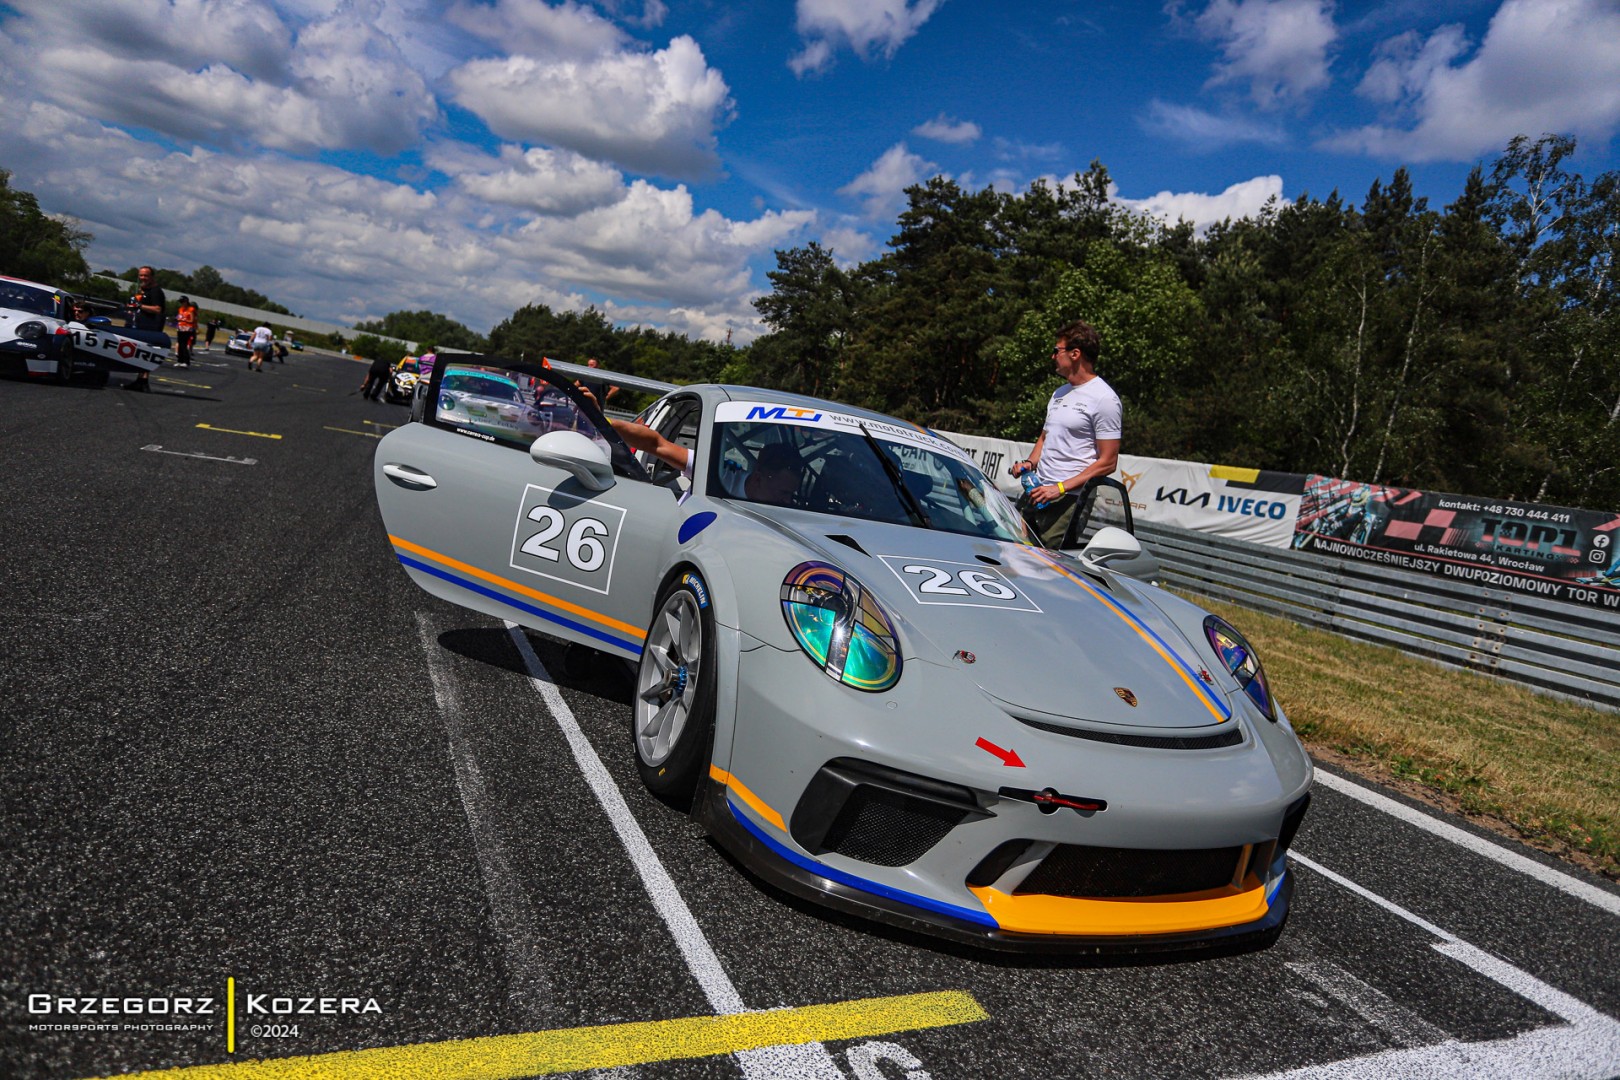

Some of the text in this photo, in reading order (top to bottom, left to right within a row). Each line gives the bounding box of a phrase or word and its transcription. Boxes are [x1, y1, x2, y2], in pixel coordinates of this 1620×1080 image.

[73, 331, 97, 347] 15
[981, 450, 1005, 480] FIAT
[1155, 486, 1211, 508] KIA
[1217, 494, 1287, 520] IVECO
[1438, 498, 1571, 524] kontakt: +48 730 444 411
[519, 504, 610, 573] 26
[1481, 517, 1581, 558] TOP1
[1313, 538, 1440, 573] NAJNOWOCZEŚNIEJSZY
[1444, 564, 1561, 596] DWUPOZIOMOWY
[1567, 586, 1599, 604] TOR
[1414, 543, 1545, 573] ul. Rakietowa 44, Wrocław
[689, 576, 706, 605] MICHELIN
[902, 564, 1018, 601] 26
